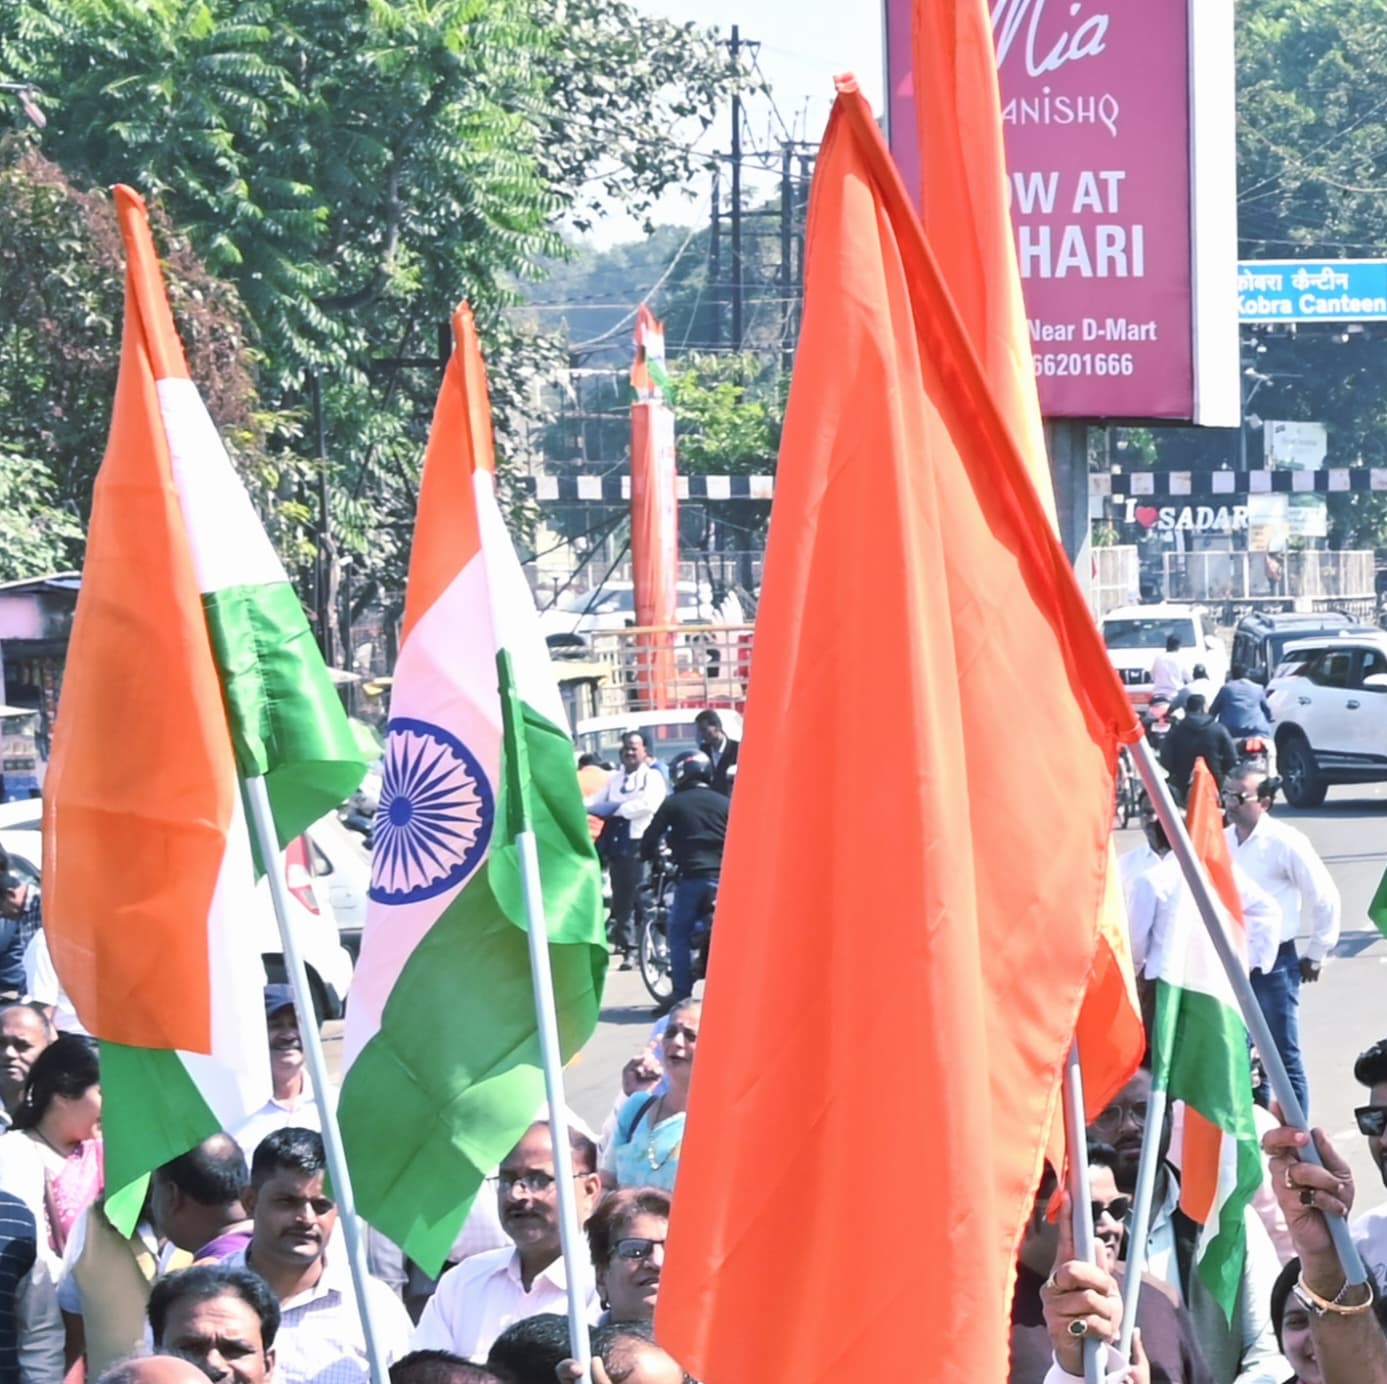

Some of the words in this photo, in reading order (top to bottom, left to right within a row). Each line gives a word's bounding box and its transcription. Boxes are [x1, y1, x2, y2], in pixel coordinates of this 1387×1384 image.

[1000, 86, 1119, 137] ANISHQ
[1072, 171, 1125, 213] AT
[1019, 224, 1144, 278] HARI
[1299, 294, 1387, 313] Canteen
[1082, 318, 1158, 341] D-Mart
[1034, 353, 1133, 376] 66201666
[1125, 498, 1138, 523] I
[1158, 505, 1249, 531] SADAR
